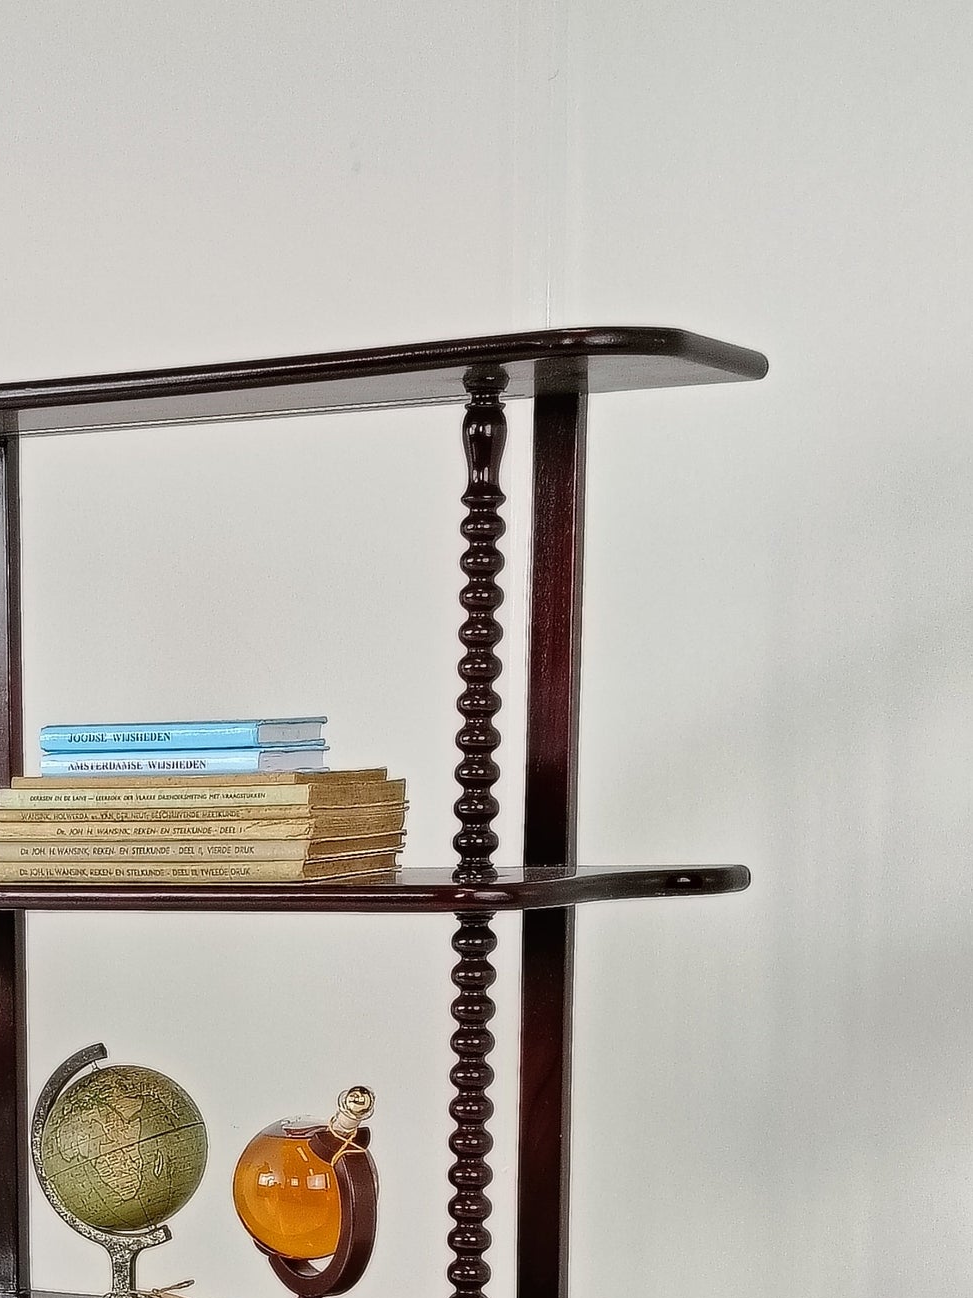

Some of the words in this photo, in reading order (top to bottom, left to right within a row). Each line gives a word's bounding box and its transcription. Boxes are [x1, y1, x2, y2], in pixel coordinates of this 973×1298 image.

[68, 732, 107, 742] JOODSE
[113, 732, 171, 742] WIJSHEDEN
[68, 762, 143, 771] AMSTERDAMSE
[147, 760, 206, 770] WIJSHEDEN
[120, 847, 129, 855] EN
[200, 868, 228, 876] TWEEDE
